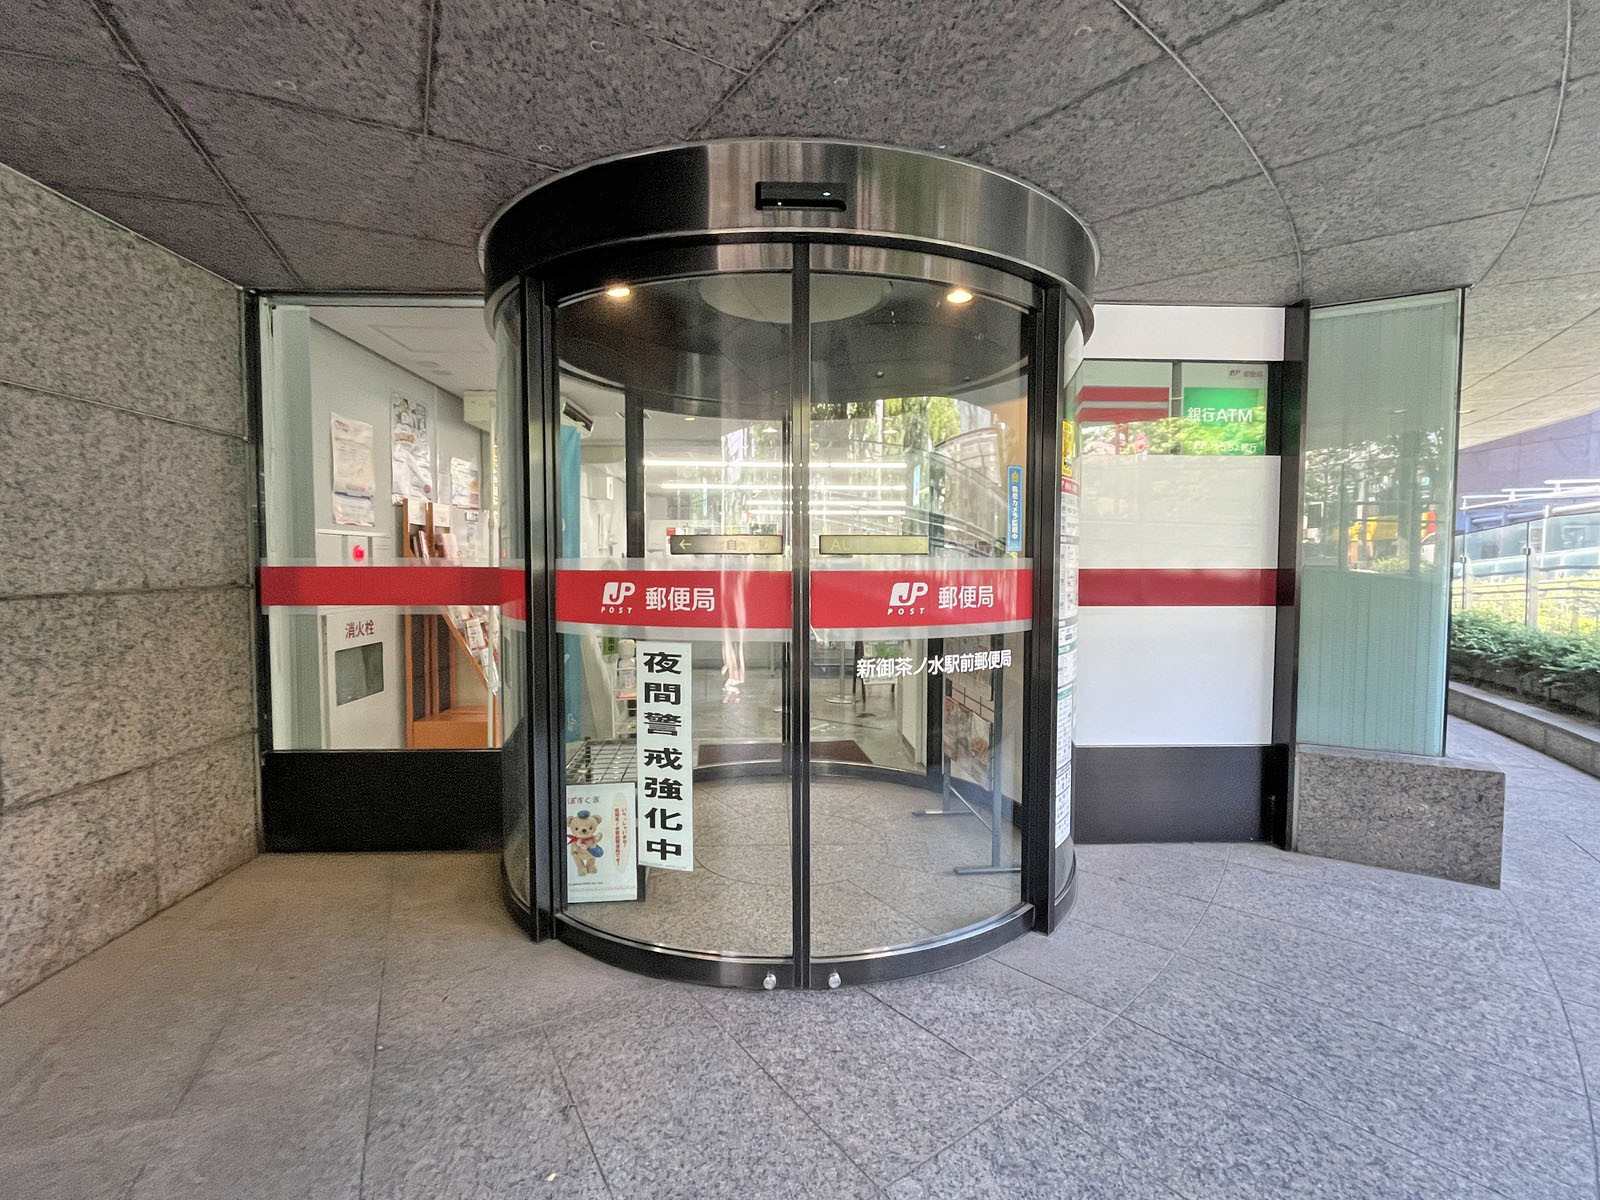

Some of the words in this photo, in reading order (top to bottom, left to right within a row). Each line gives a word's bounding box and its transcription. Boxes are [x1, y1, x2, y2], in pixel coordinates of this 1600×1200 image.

[1187, 407, 1252, 422] 銀行ATM
[602, 582, 635, 605] JP
[645, 587, 715, 612] 郵便局
[889, 582, 928, 606] JP
[938, 585, 994, 609] 郵便局
[887, 607, 925, 616] POST
[345, 620, 374, 638] 消火栓
[856, 649, 1012, 678] 新御茶ノ水駅前郵便局
[643, 652, 683, 860] 夜間警戒強化中
